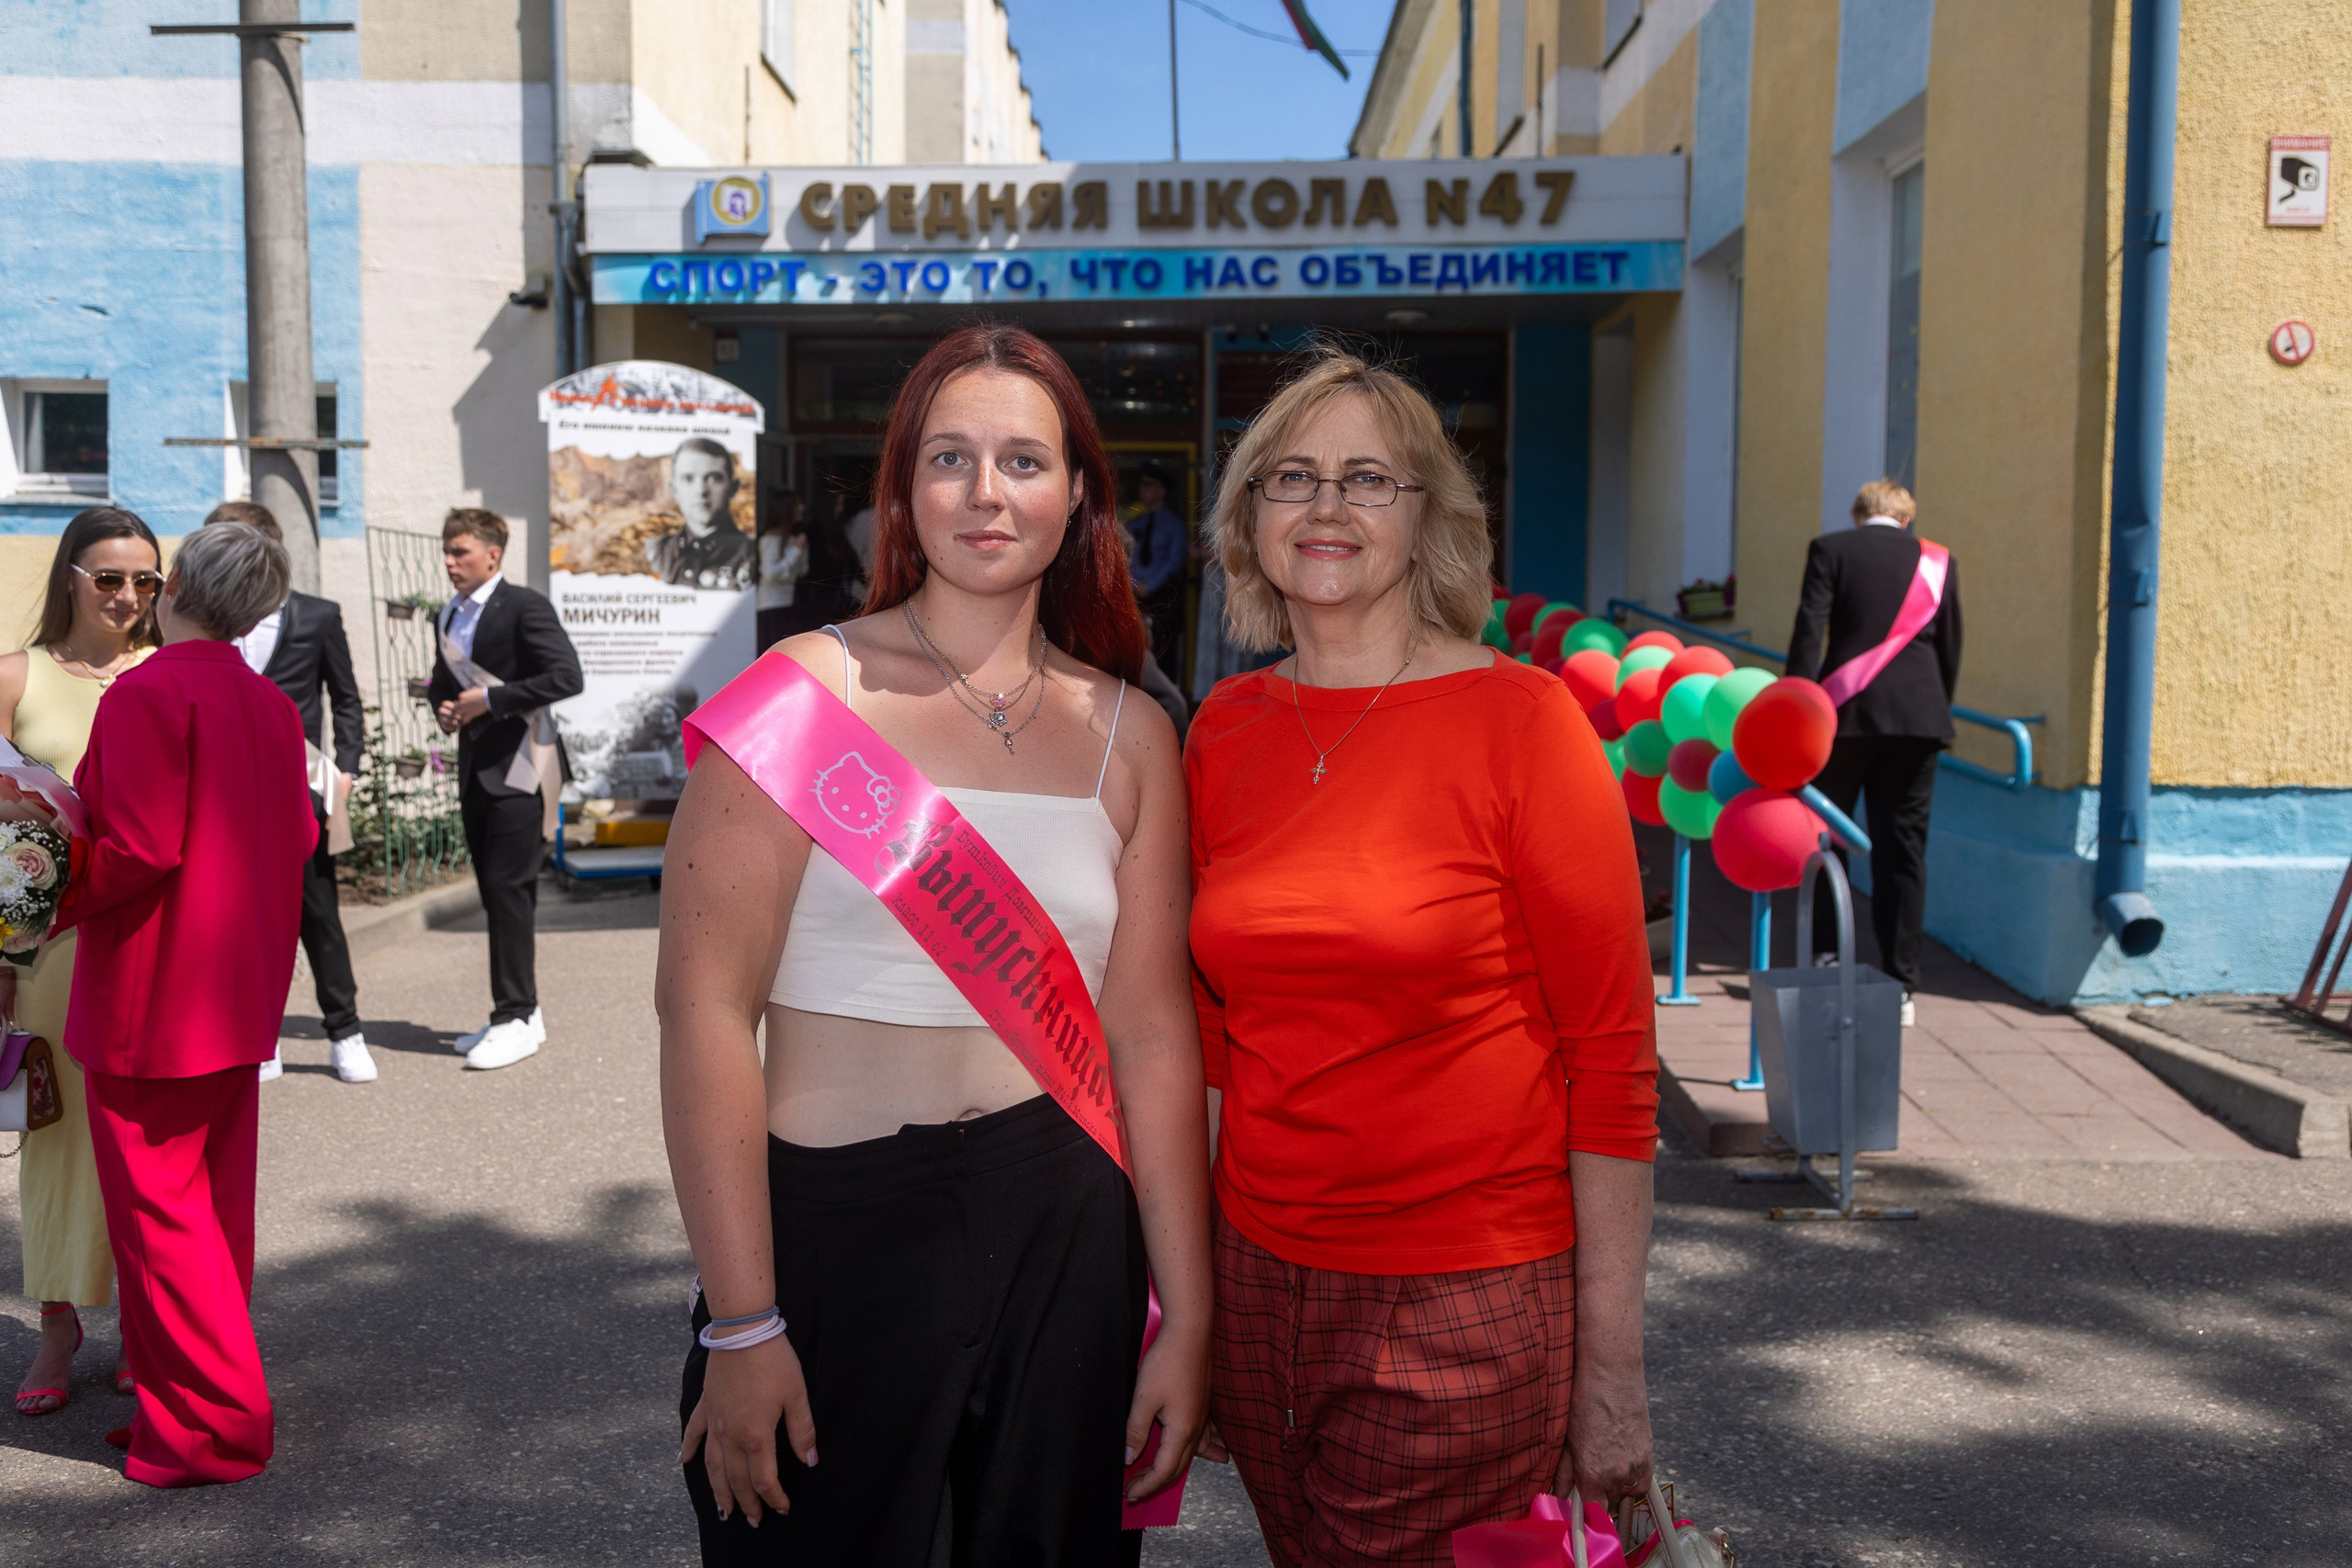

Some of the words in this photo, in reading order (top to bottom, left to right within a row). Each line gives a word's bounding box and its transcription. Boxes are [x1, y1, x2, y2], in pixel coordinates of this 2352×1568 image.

[799, 181, 1108, 239] СРЕДНЯЯ
[1136, 177, 1398, 229] ШКОЛА
[649, 261, 806, 293] СПОРТ
[860, 260, 951, 293] ЭТО
[974, 258, 1048, 298] ТО,
[1069, 257, 1160, 291] ЧТО
[1184, 255, 1279, 290] НАС
[1299, 251, 1628, 292] ОБЪЕДИНЯЕТ
[561, 592, 623, 604] ВАСИЛИЙ
[626, 593, 697, 604] СЕРГЕЕВИЧ
[562, 607, 661, 625] МИЧУРИН
[890, 892, 920, 927] класс
[919, 923, 934, 942] 11
[1003, 885, 1052, 946] Доминика
